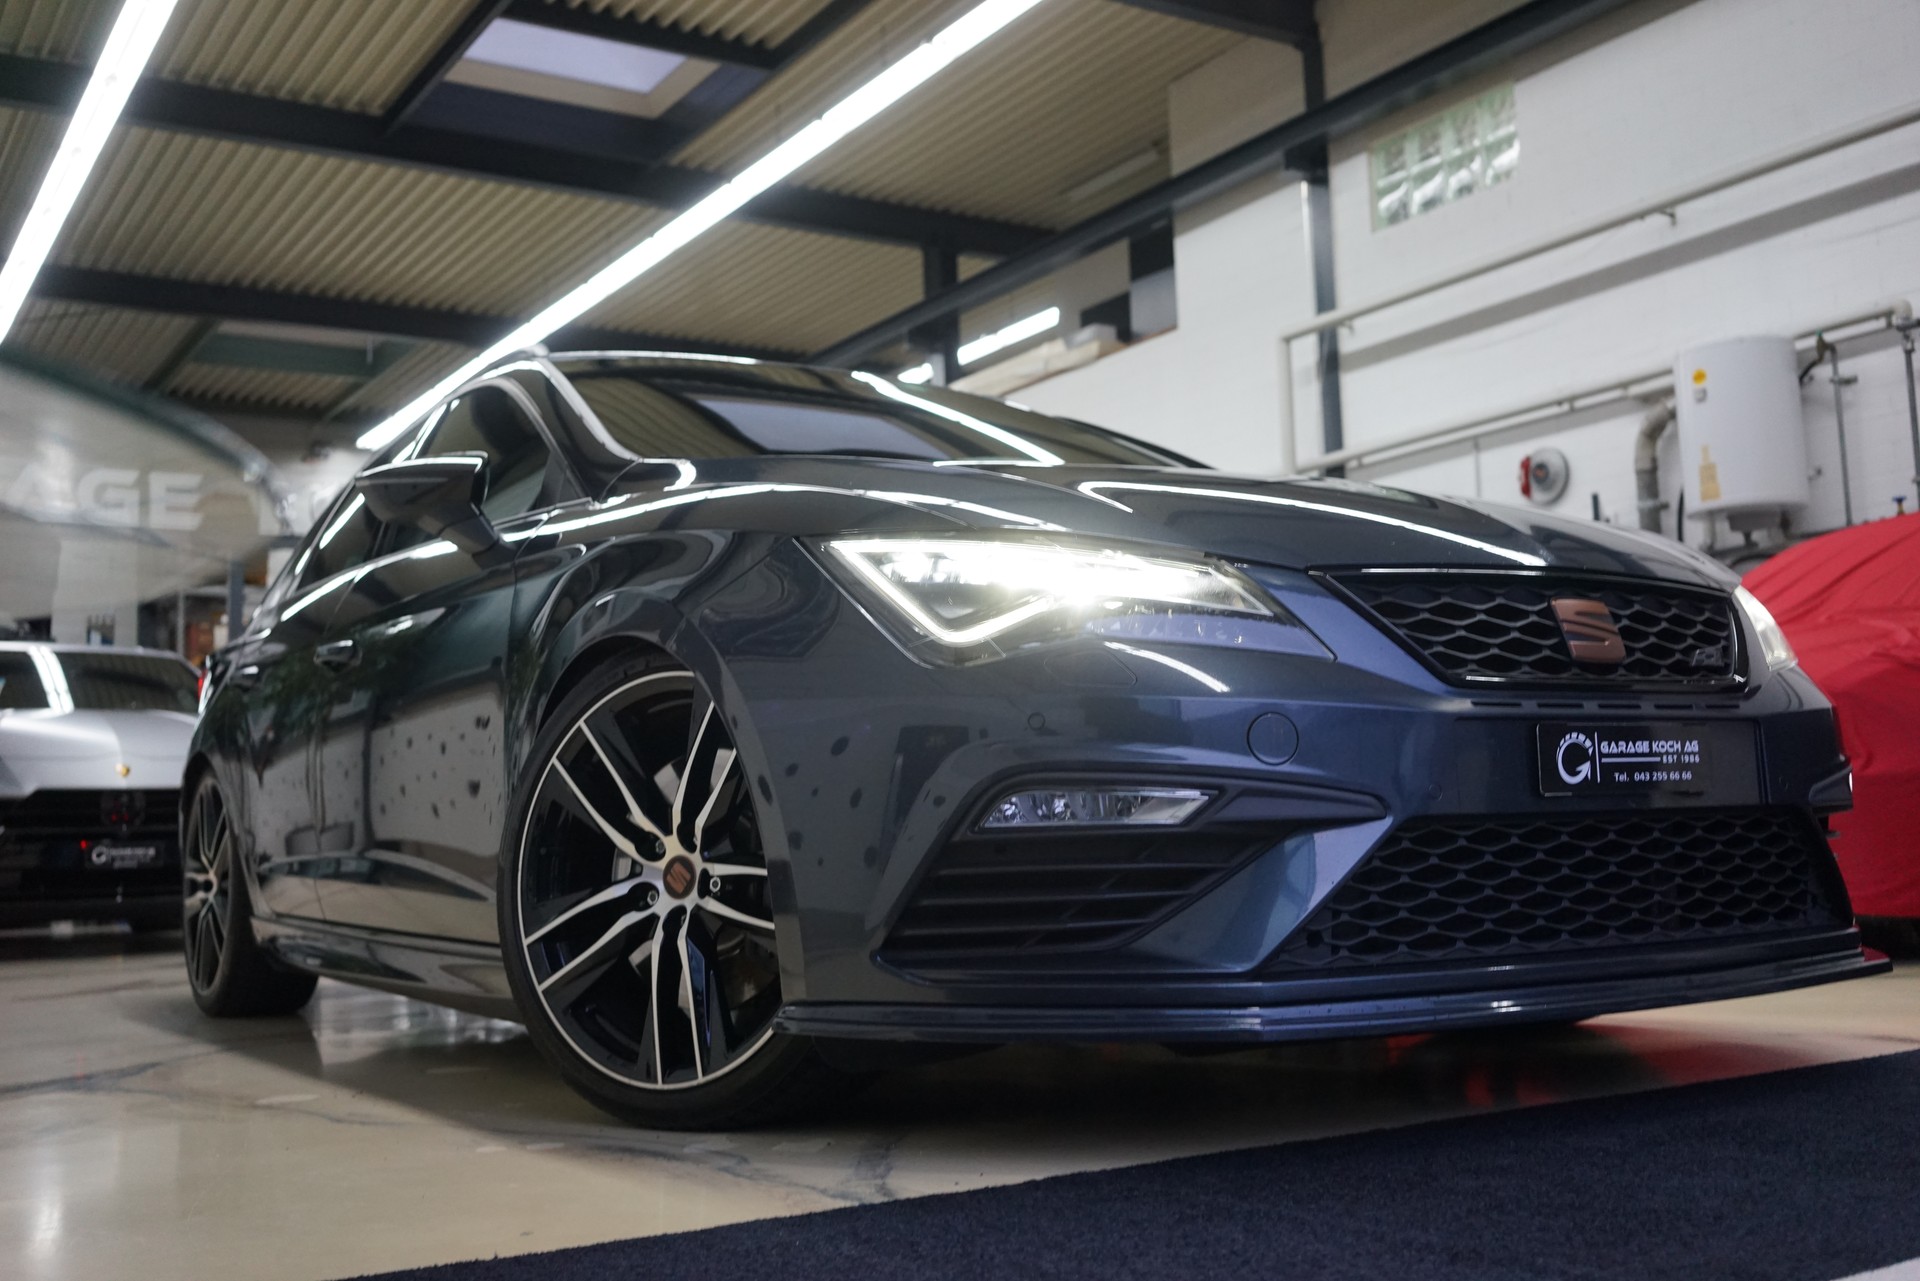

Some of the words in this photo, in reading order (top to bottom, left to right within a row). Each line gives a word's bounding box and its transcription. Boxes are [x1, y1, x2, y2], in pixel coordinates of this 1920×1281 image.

[1601, 741, 1650, 754] GARAGE
[1652, 740, 1682, 753] KOCH
[1684, 740, 1699, 753] AG
[1663, 755, 1677, 764] EST
[1614, 772, 1629, 782] Tel.
[1634, 771, 1650, 781] 043
[1652, 771, 1668, 781] 255
[1669, 770, 1680, 781] 66
[1682, 770, 1692, 780] 66
